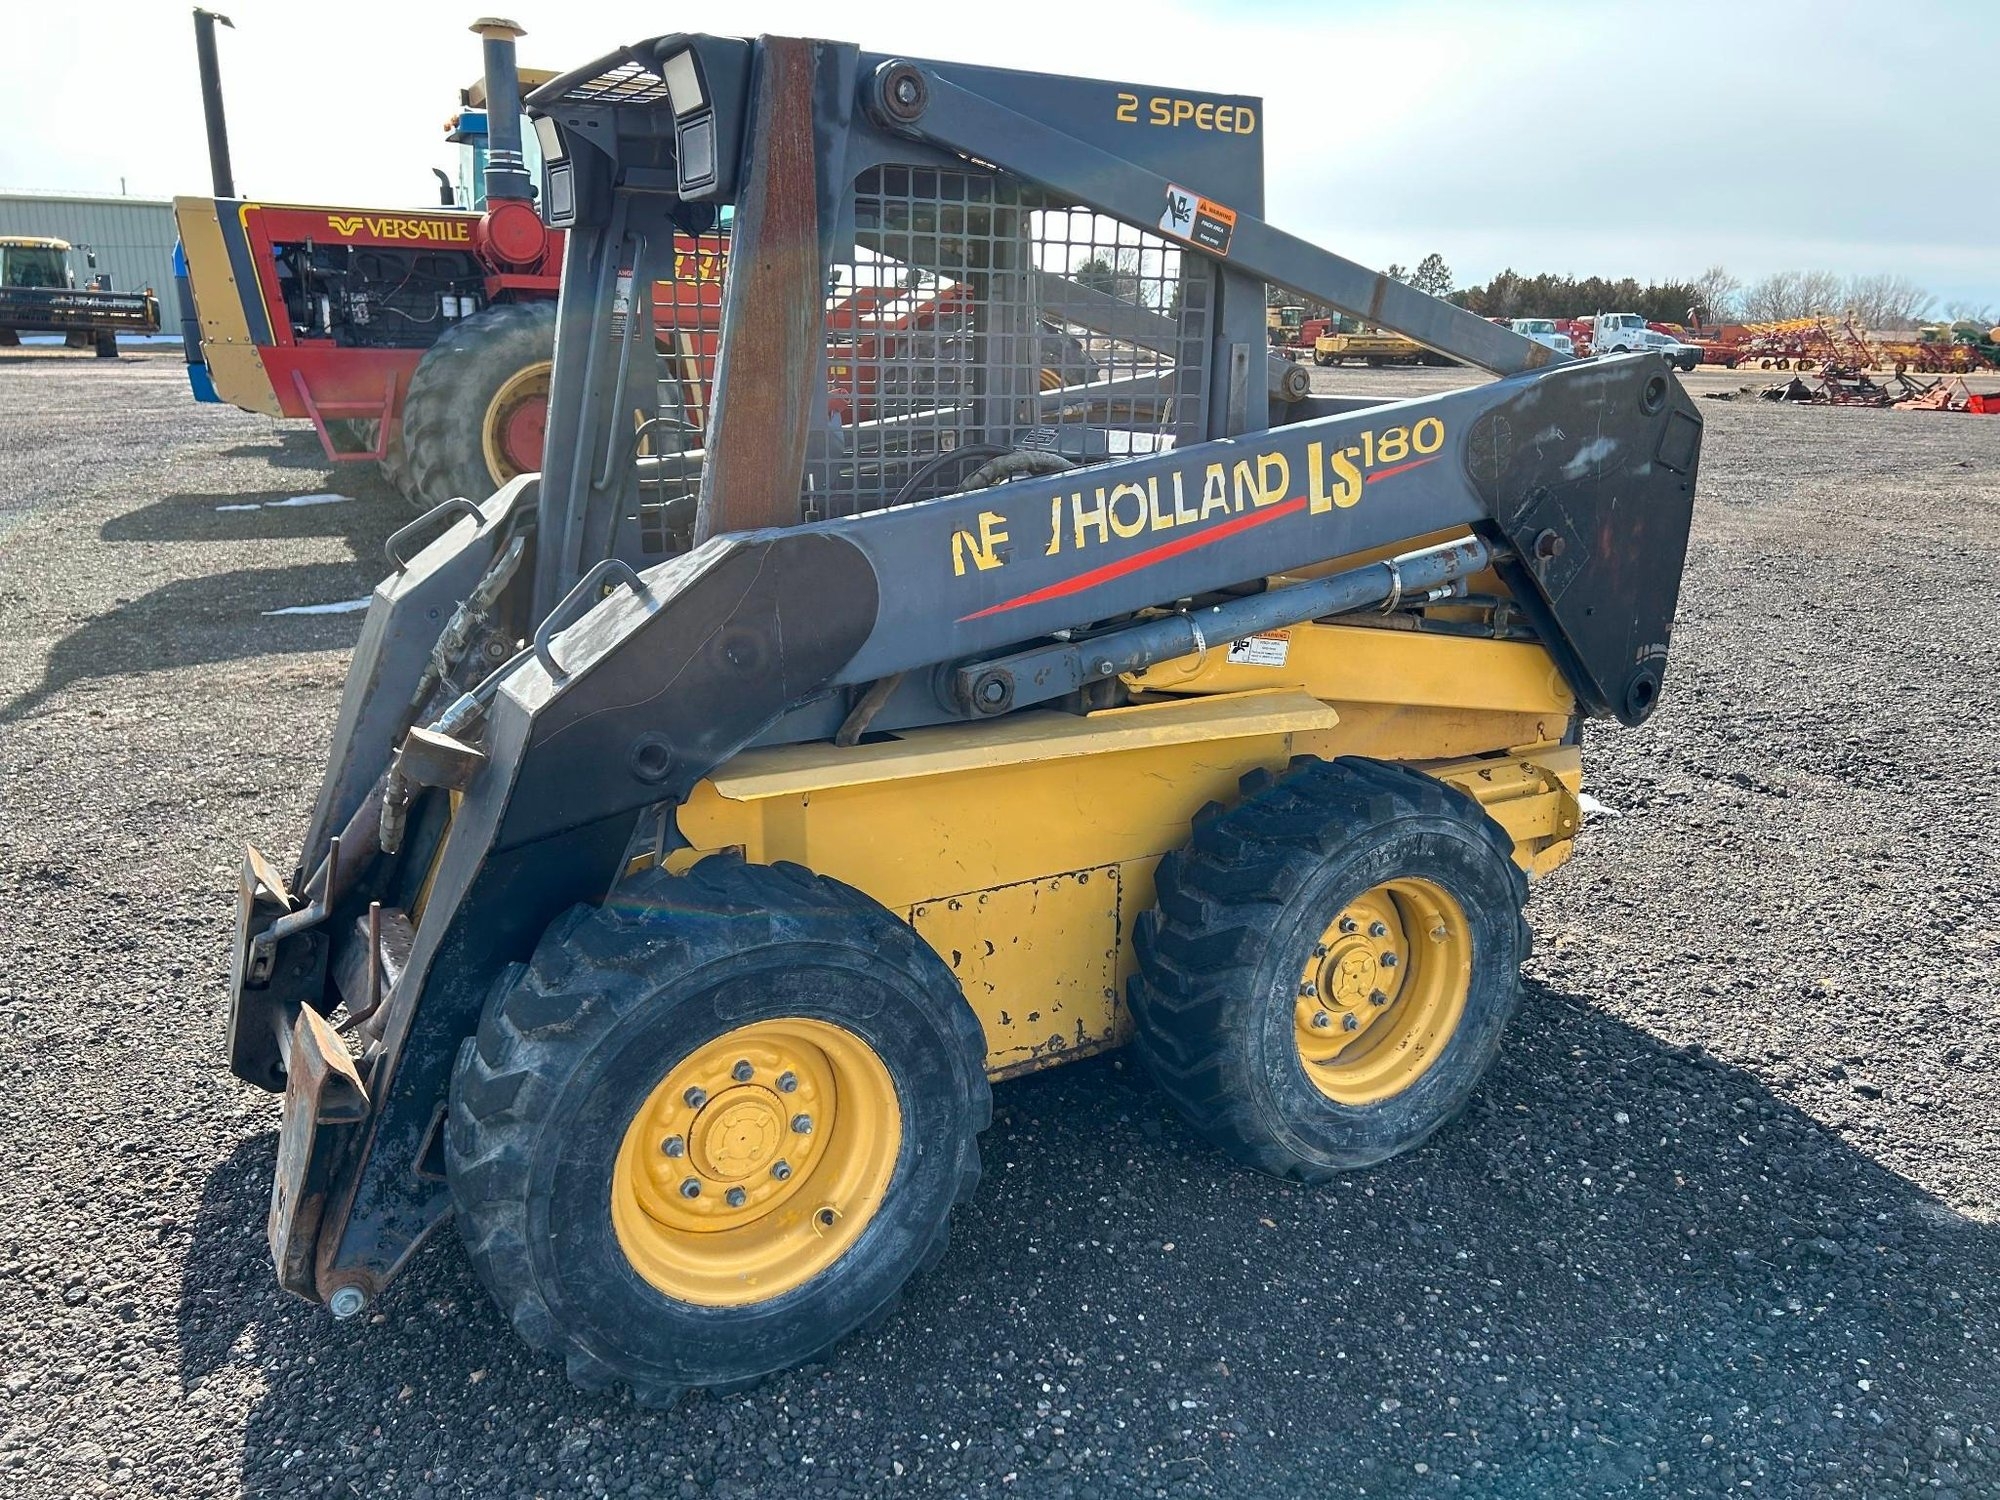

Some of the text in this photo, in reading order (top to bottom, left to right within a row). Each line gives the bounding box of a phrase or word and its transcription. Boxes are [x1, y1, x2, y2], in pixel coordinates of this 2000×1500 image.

[1117, 93, 1256, 135] 2 SPEED
[364, 217, 470, 241] VERSATILE
[1072, 452, 1291, 549] HOLLAND
